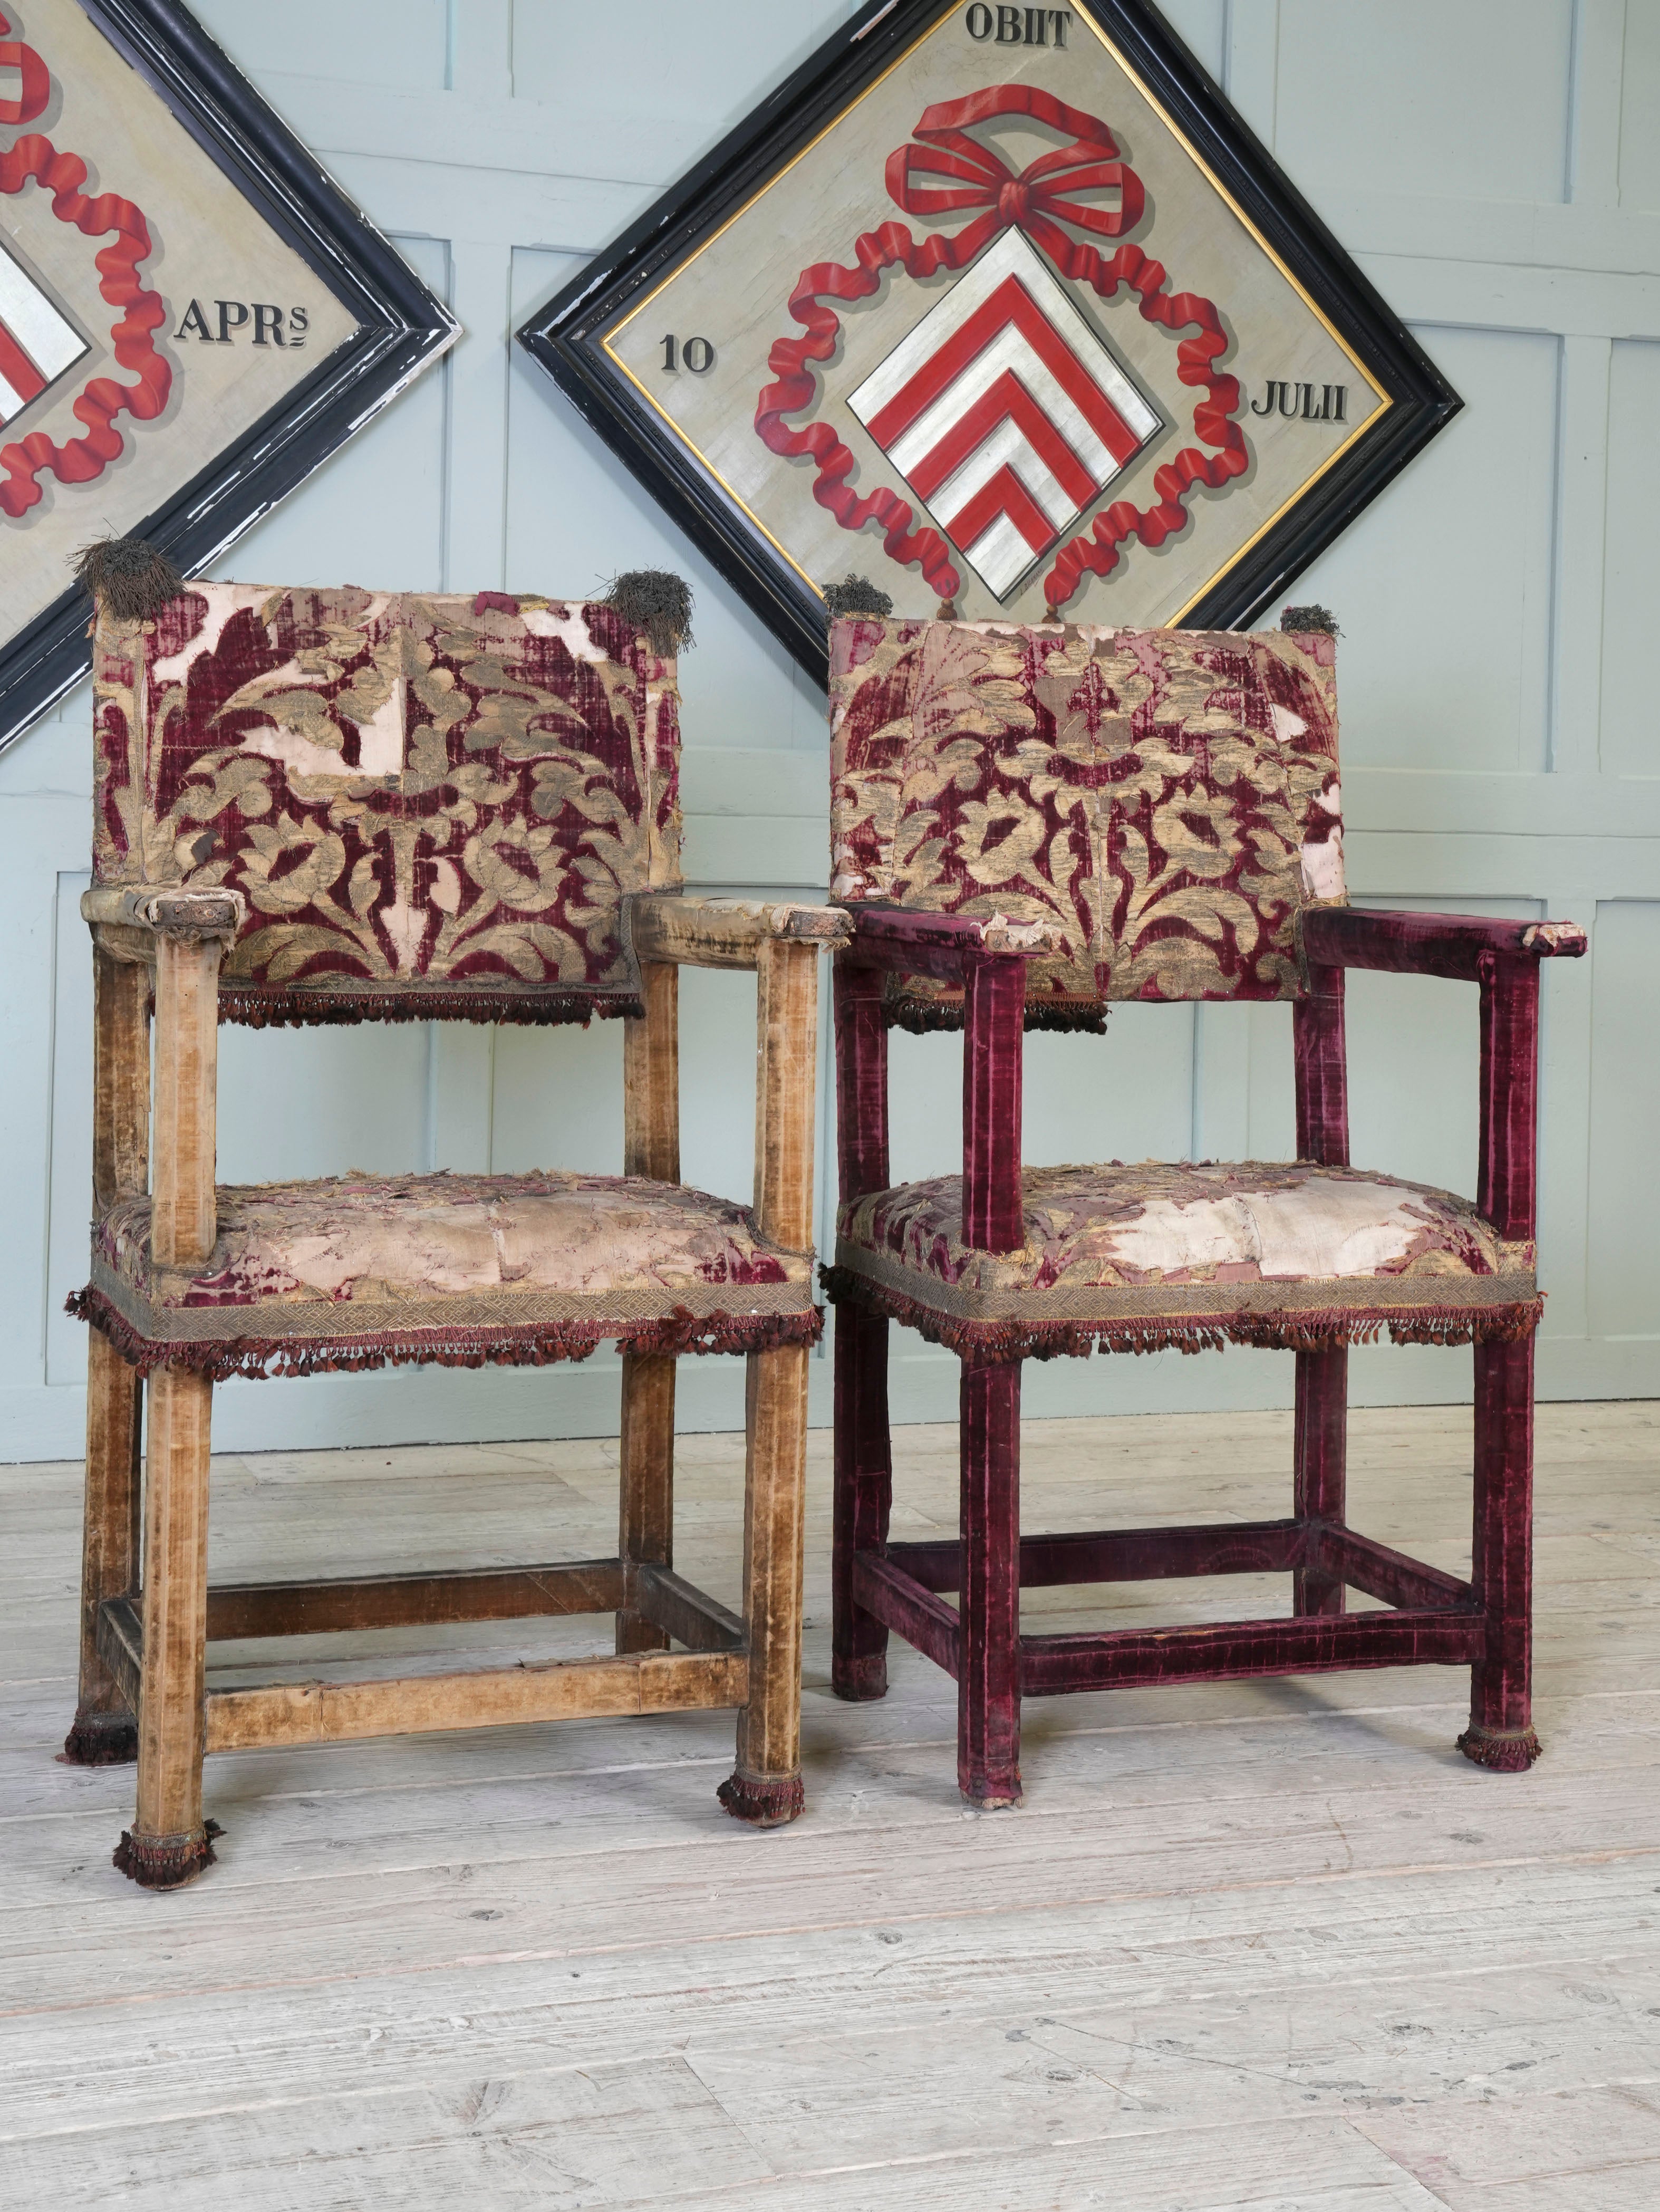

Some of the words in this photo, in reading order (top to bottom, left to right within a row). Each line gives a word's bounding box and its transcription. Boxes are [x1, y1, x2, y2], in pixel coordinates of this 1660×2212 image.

[966, 2, 1070, 47] OBIIT
[659, 334, 714, 372] 10
[1251, 380, 1346, 420] JULII
